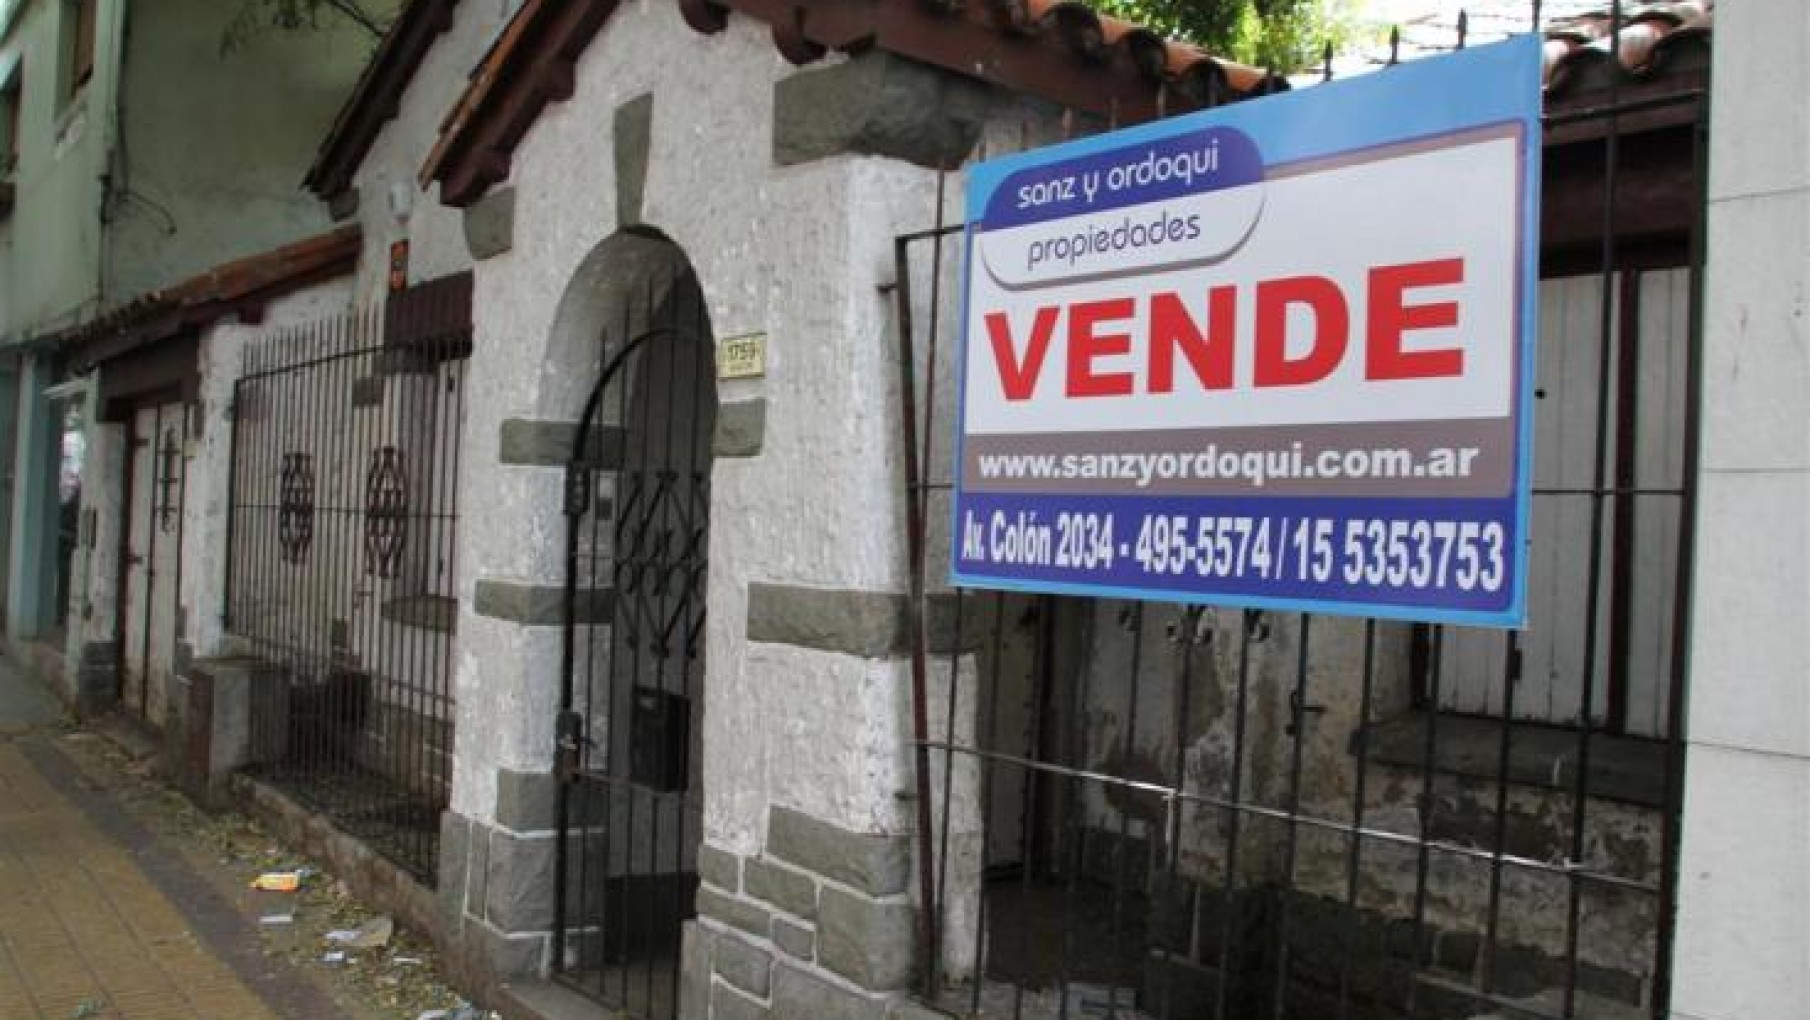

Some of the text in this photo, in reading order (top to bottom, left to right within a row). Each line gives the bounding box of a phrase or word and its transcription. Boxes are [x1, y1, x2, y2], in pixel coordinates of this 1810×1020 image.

[1017, 137, 1220, 208] sanz y ordoqui
[1027, 209, 1201, 272] propiedades
[983, 256, 1465, 402] VENDE
[978, 442, 1480, 486] www.sanzyordoqui.com.ar
[990, 509, 1051, 566] Colón
[1055, 511, 1114, 571] 2034
[1343, 519, 1504, 592] 5353753
